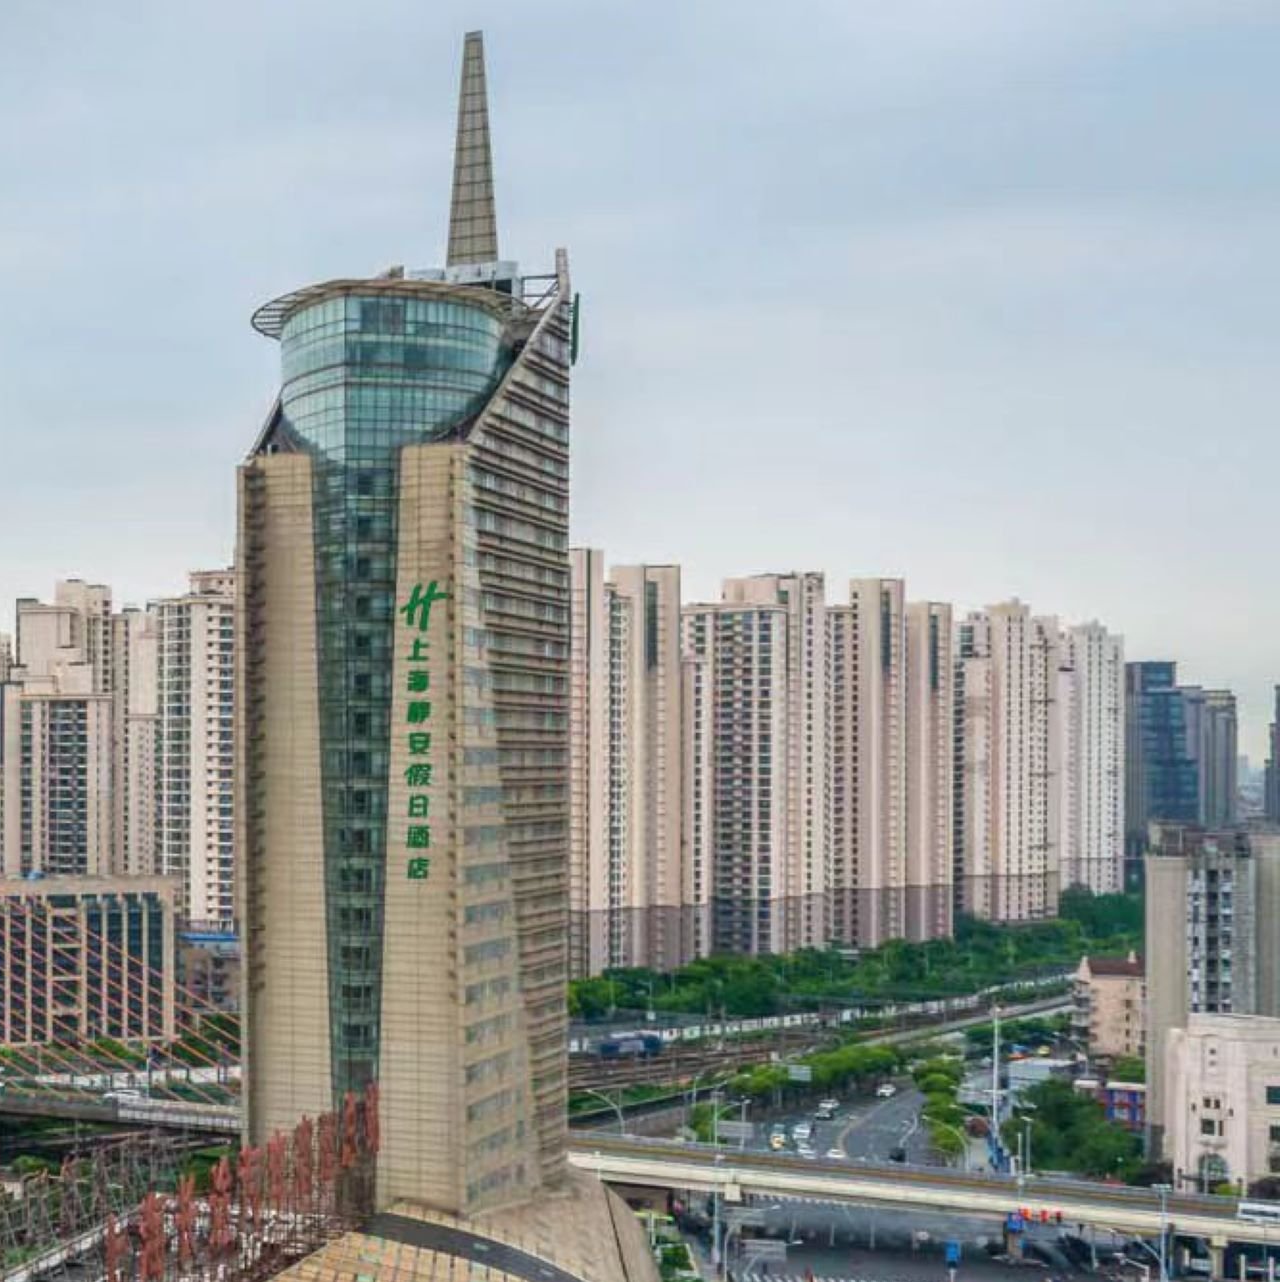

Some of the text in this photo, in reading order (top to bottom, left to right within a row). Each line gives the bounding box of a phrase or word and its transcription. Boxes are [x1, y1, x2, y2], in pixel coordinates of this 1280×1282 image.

[404, 637, 432, 880] 上海静安假日酒店
